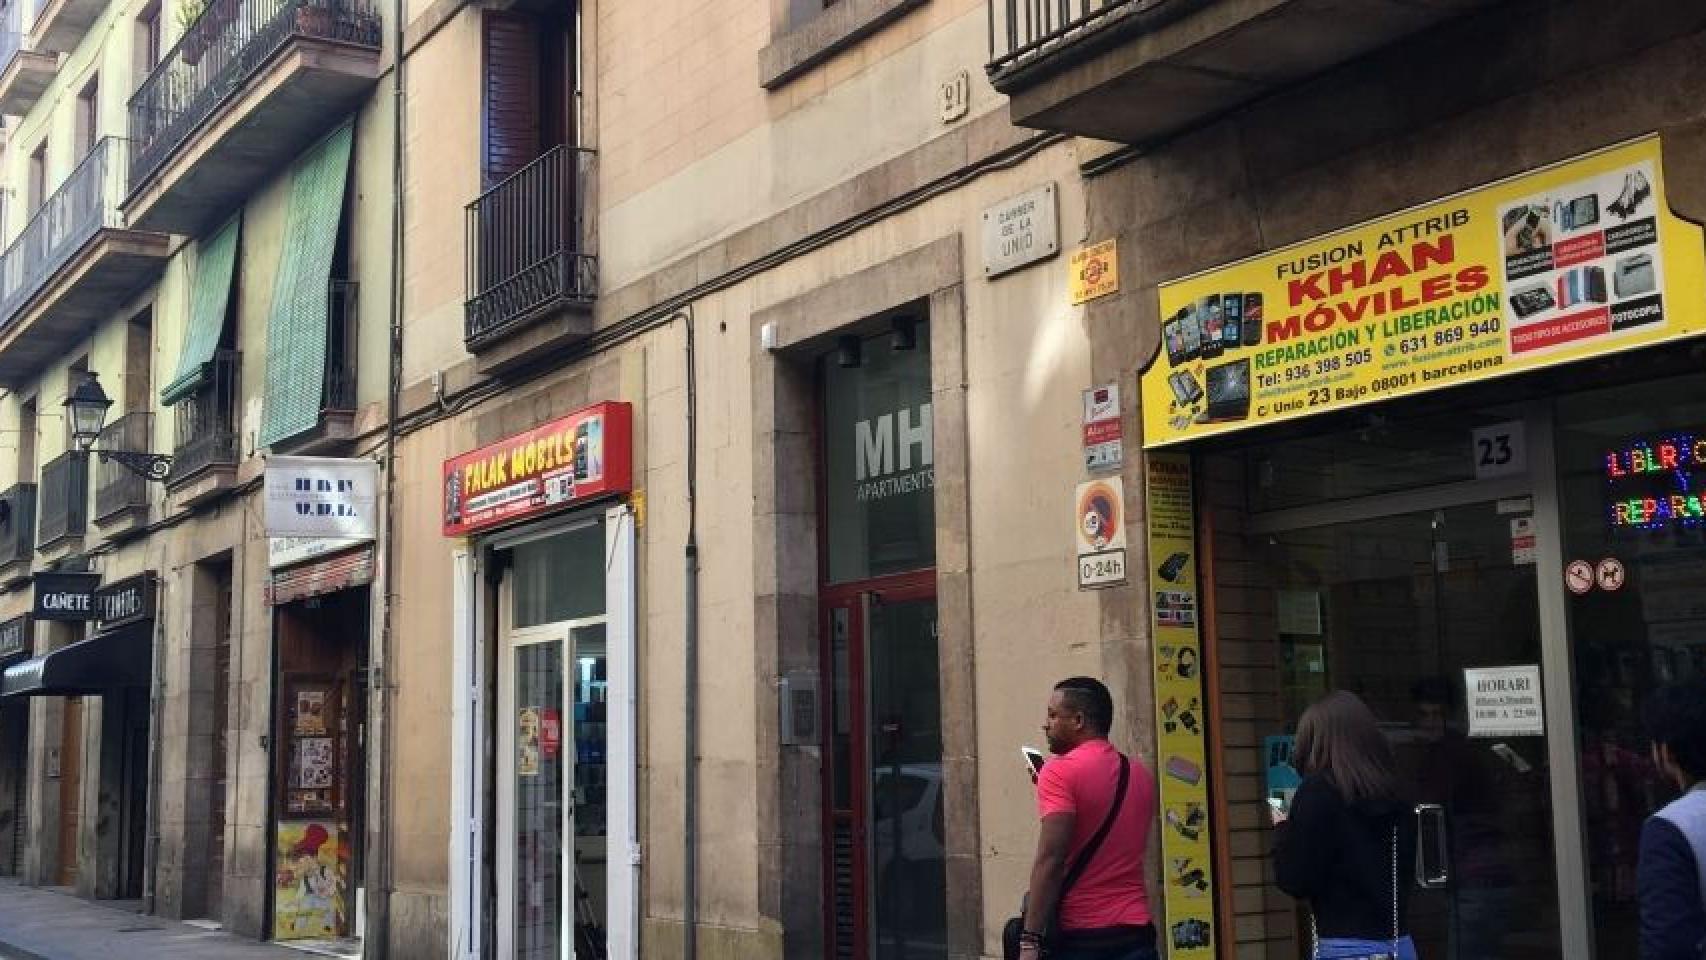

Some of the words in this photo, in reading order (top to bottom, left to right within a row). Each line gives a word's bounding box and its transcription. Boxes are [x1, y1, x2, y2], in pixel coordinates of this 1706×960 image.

[1277, 240, 1362, 280] FUSION
[1377, 208, 1470, 250] ATTRIB
[1288, 233, 1455, 307] KHAN
[1265, 265, 1490, 344] MÓVILES
[1255, 328, 1359, 370] REPARACIÓN
[1364, 323, 1377, 342] Y
[1383, 292, 1500, 338] LIBERACIÓN
[1399, 335, 1428, 355] 631
[1433, 326, 1463, 347] 869
[1469, 317, 1501, 337] 940
[1256, 367, 1281, 388] Tel:
[1285, 361, 1311, 382] 936
[1315, 355, 1341, 375] 398
[1345, 348, 1372, 367] 505
[1307, 387, 1331, 407] 23
[1335, 383, 1367, 402] Bajo
[1371, 371, 1416, 393] 08001
[1422, 354, 1503, 381] barcelona
[855, 403, 933, 481] MH
[1476, 434, 1512, 467] 23
[1083, 560, 1121, 580] 0-24h
[43, 591, 91, 611] CAÑETE
[1477, 677, 1530, 692] HORARI
